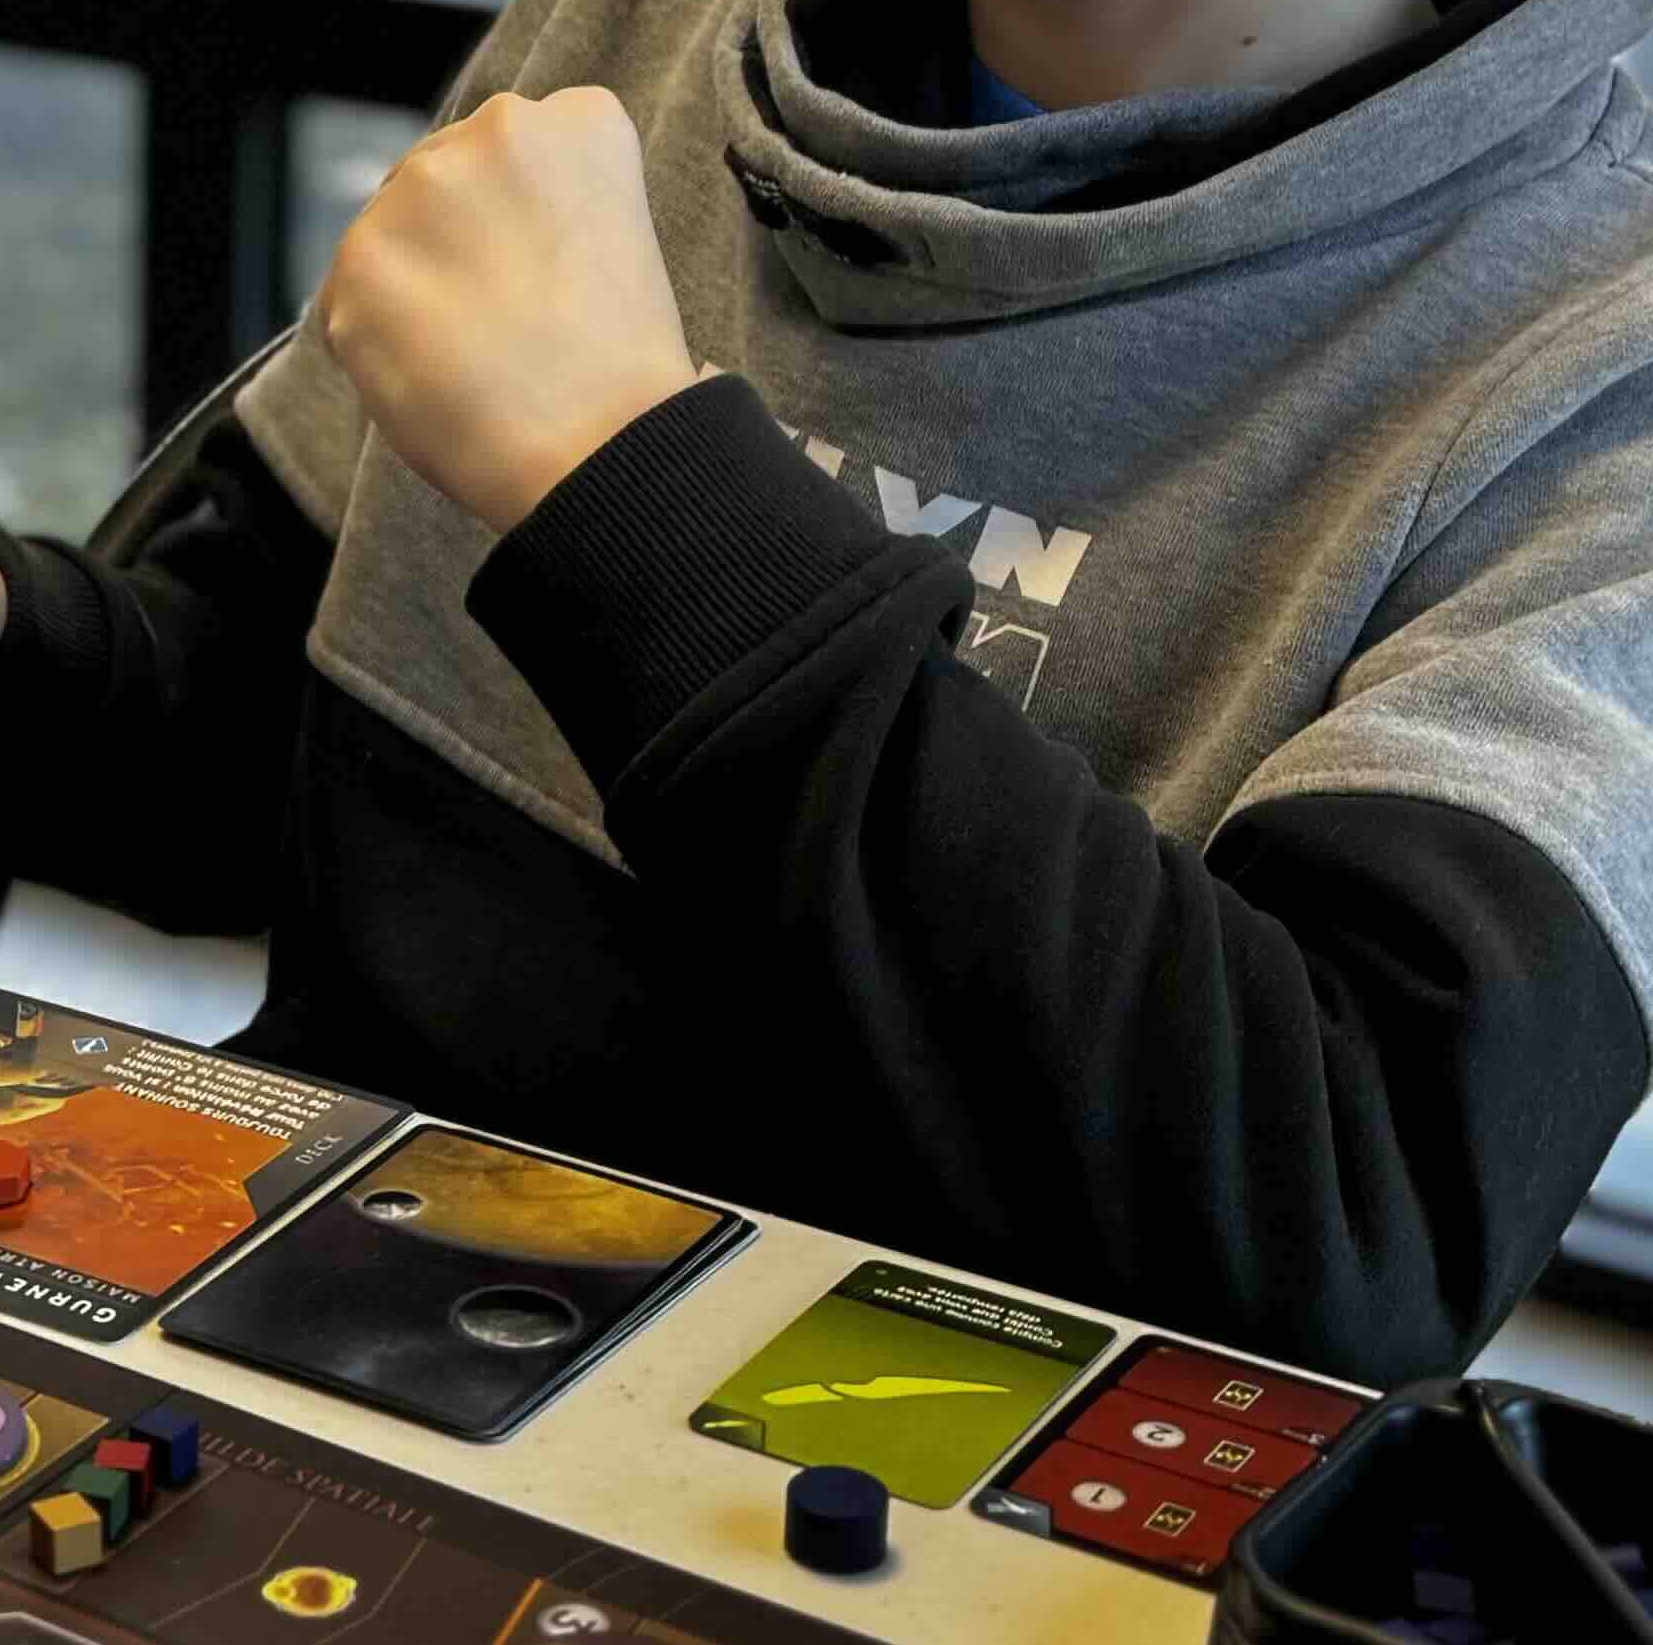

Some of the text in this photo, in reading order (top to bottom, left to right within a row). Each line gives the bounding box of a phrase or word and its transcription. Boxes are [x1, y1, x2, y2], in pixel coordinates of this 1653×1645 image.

[102, 1063, 144, 1082] vous
[201, 1106, 292, 1141] TOUJOURS
[51, 1268, 141, 1304] MAISON
[1147, 1424, 1174, 1443] 2
[1089, 1486, 1108, 1504] 1
